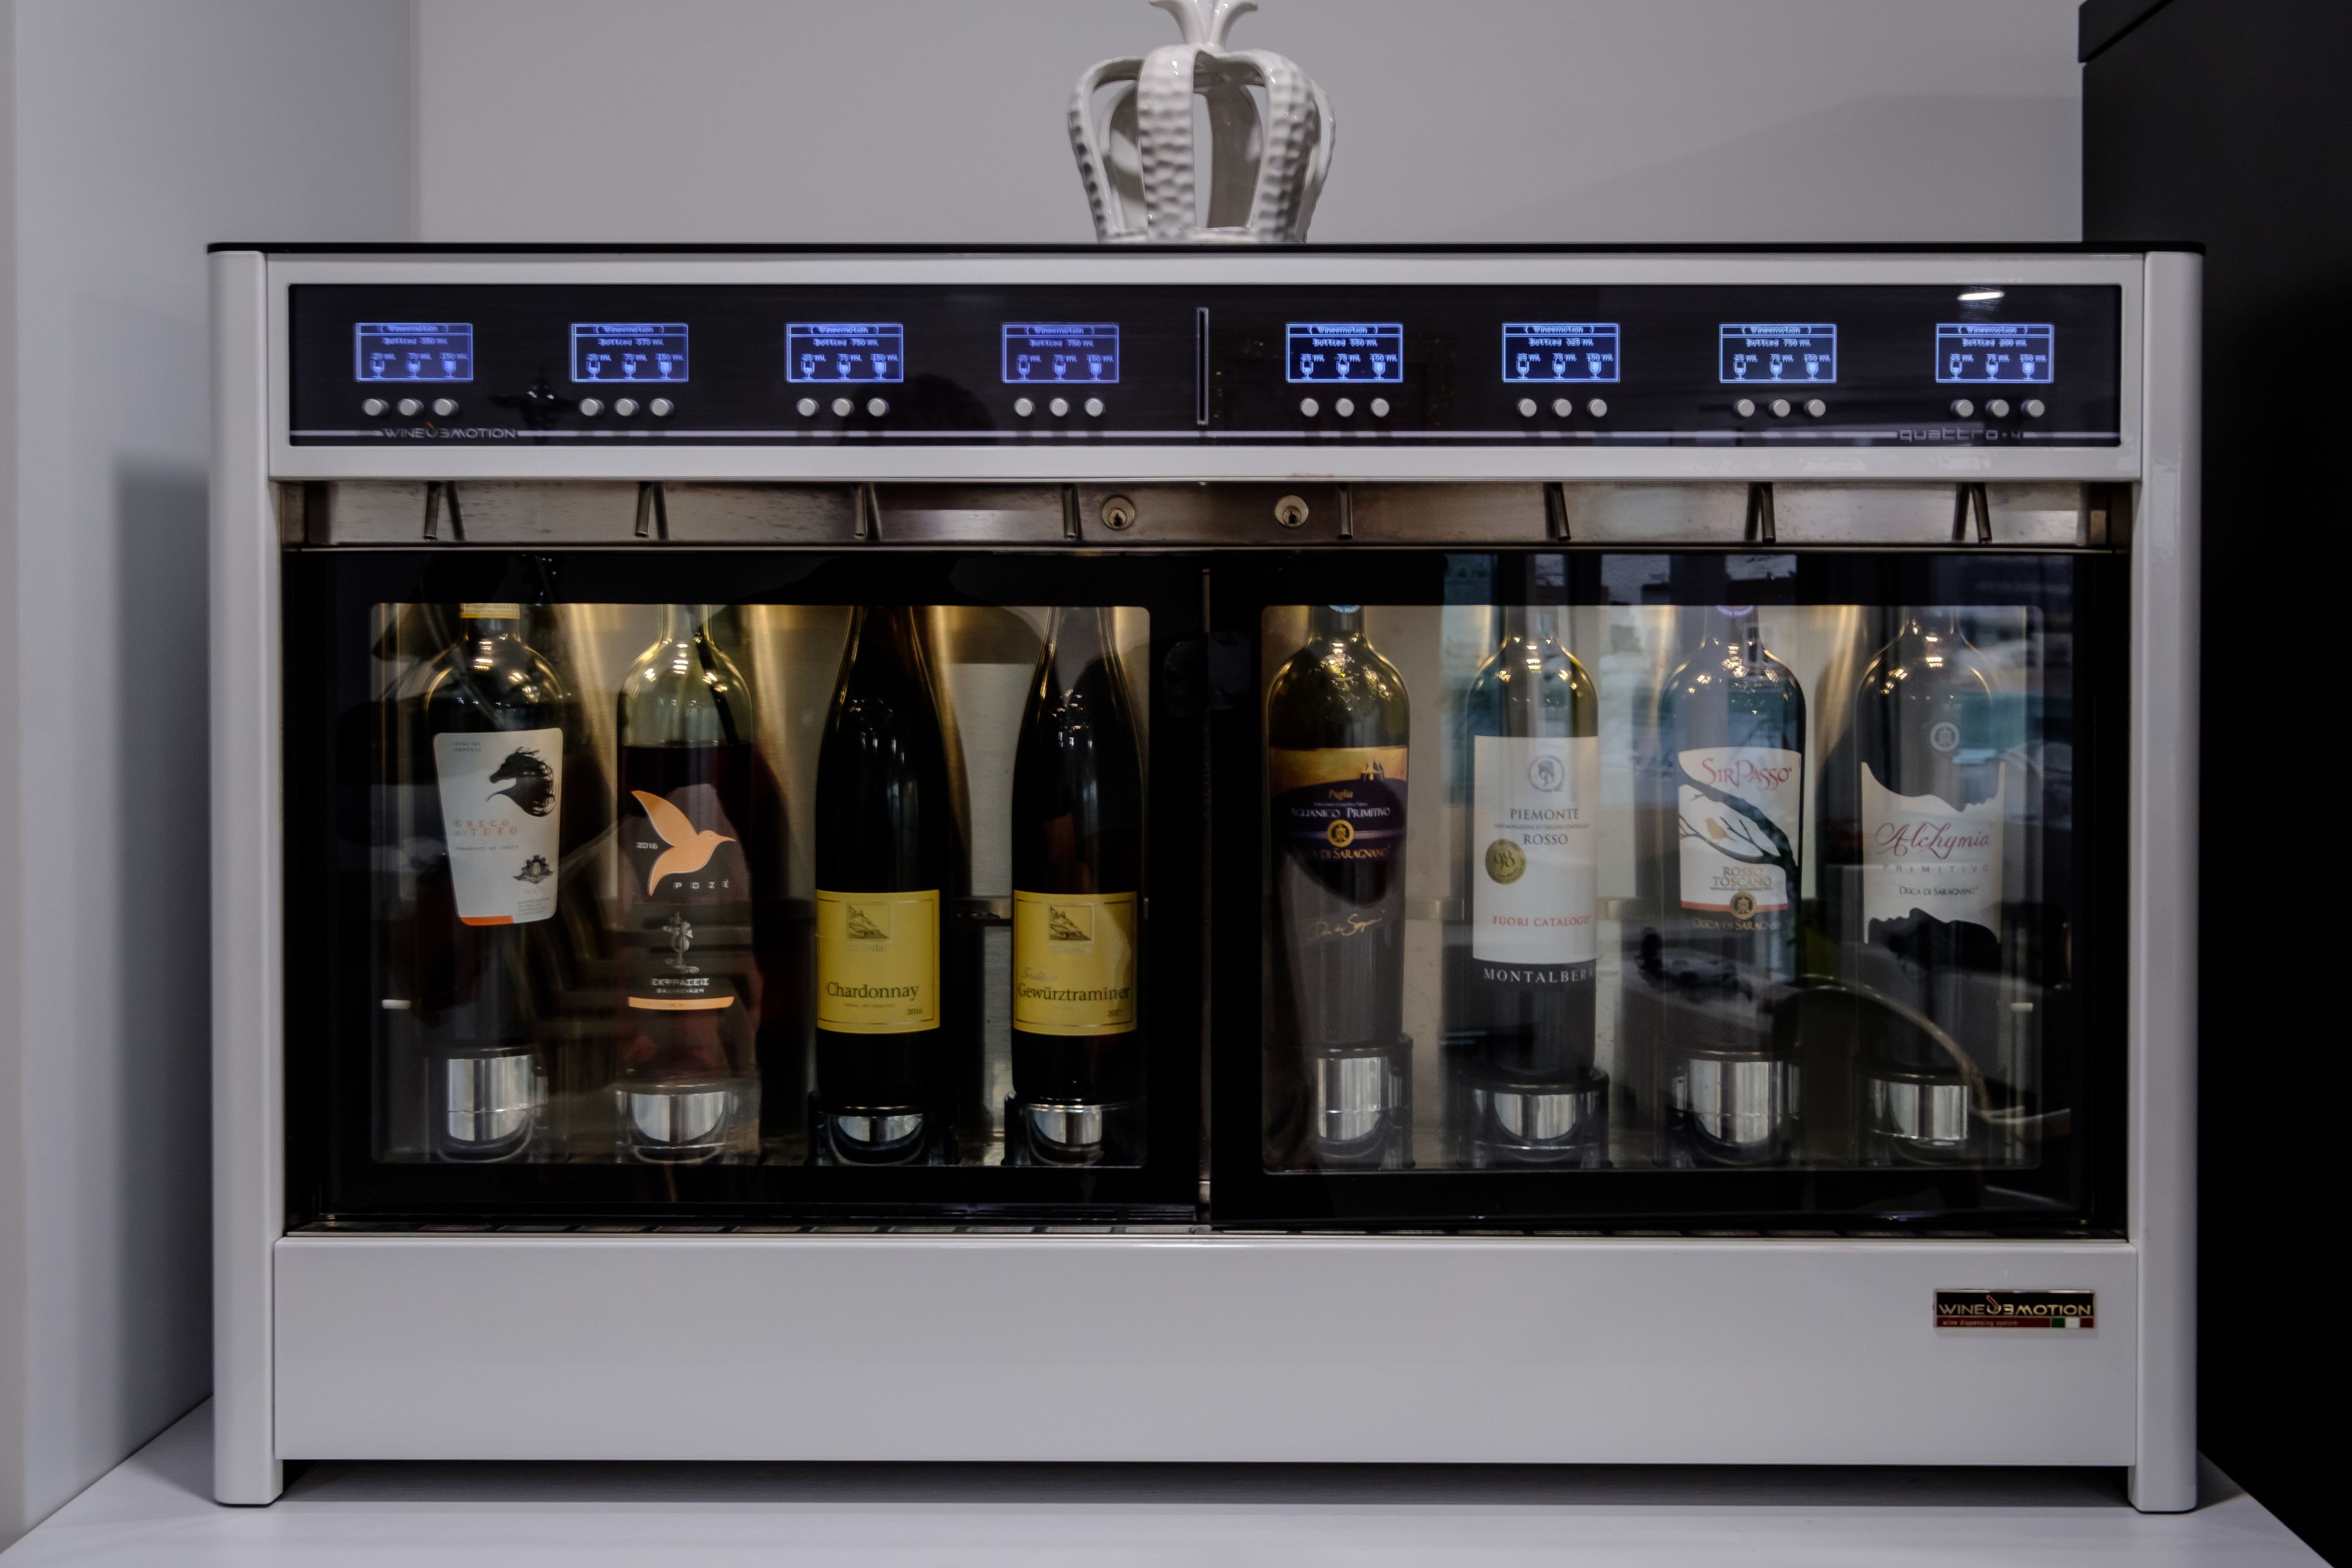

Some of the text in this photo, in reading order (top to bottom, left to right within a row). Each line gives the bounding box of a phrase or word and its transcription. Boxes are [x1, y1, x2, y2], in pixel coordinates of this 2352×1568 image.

[1329, 789, 1353, 801] Puglia
[1347, 807, 1391, 818] PRIMITIVO
[1510, 809, 1579, 820] PIEMONTE
[1523, 834, 1569, 845] ROSSO
[636, 842, 658, 850] 2016
[1493, 850, 1515, 872] 98
[1723, 866, 1763, 876] ROSSO
[1882, 863, 1989, 873] PRIMITIVO
[1712, 876, 1773, 887] TOSCANO
[1493, 915, 1589, 927] FUORI CATALOGO
[827, 982, 919, 1001] Chardonnay
[1018, 982, 1130, 1001] Gewürztraminer
